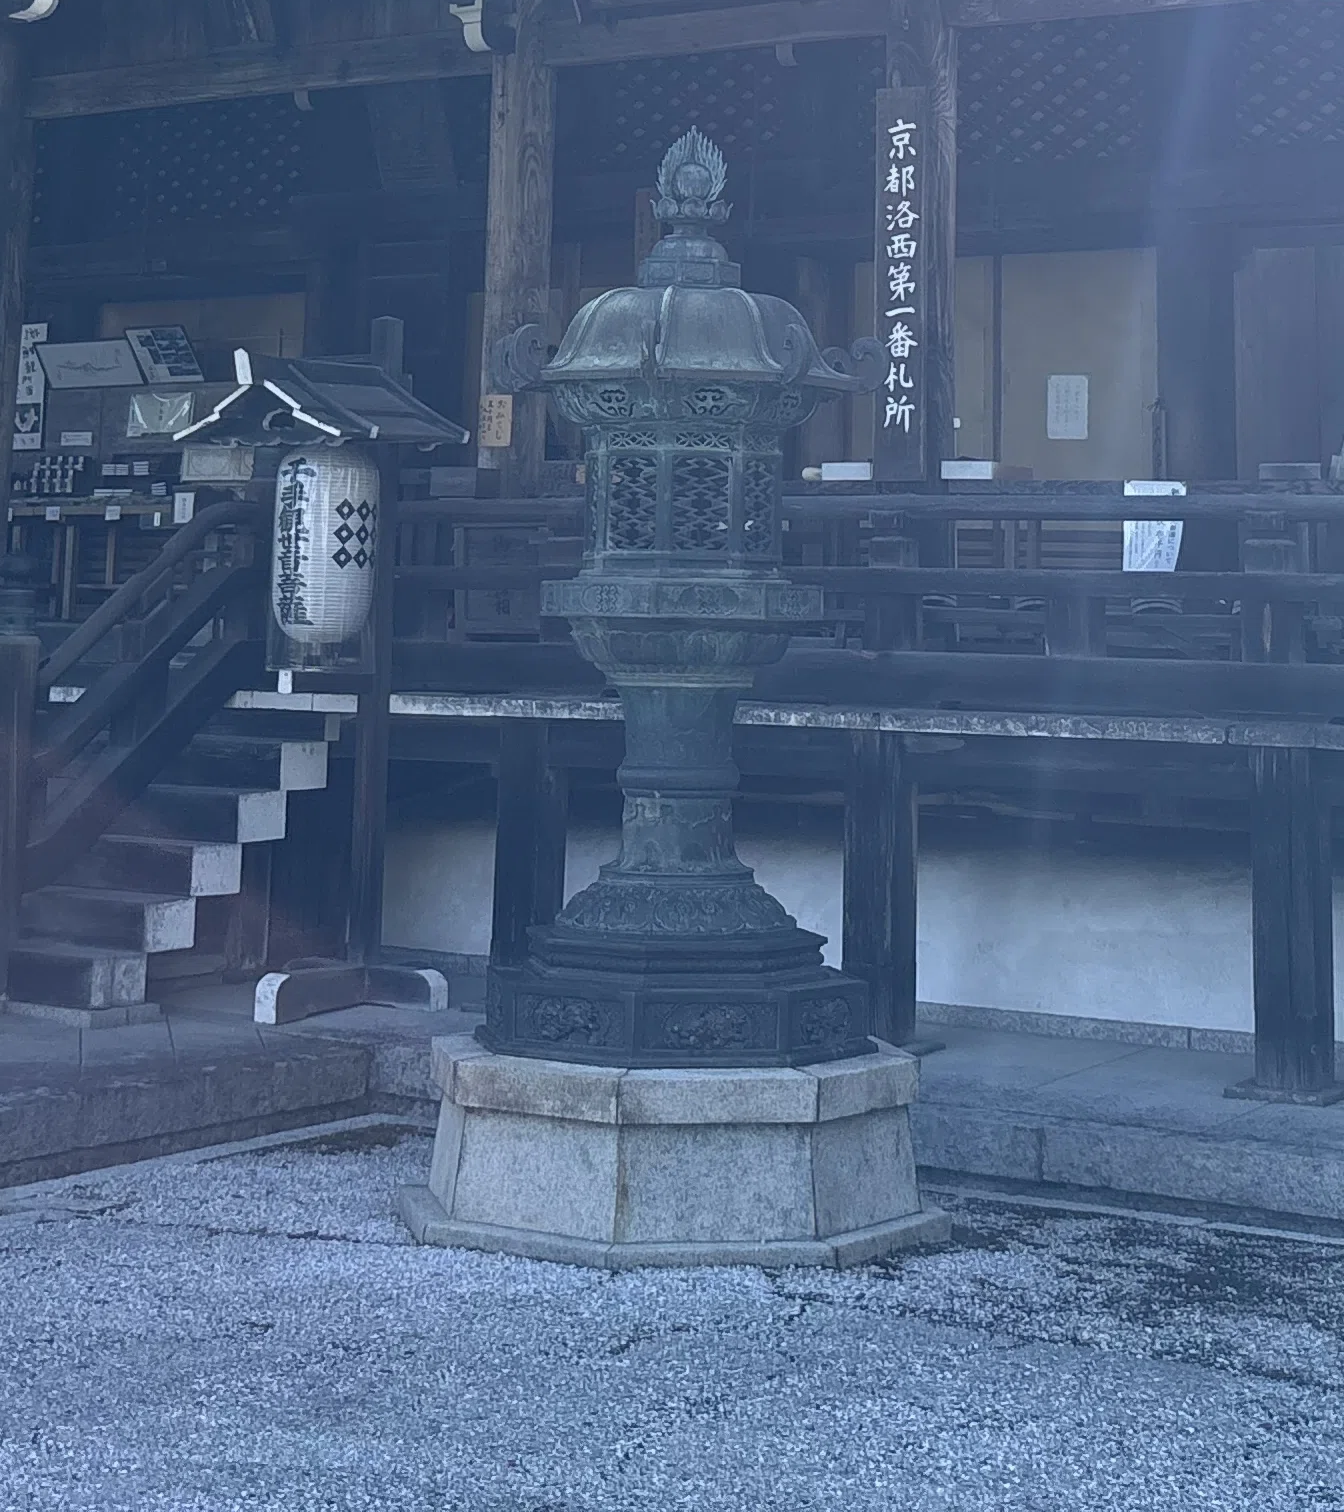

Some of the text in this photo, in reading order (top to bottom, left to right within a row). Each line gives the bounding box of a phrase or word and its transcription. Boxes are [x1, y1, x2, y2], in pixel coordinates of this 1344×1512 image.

[883, 118, 921, 434] 京都洛西第一番札所
